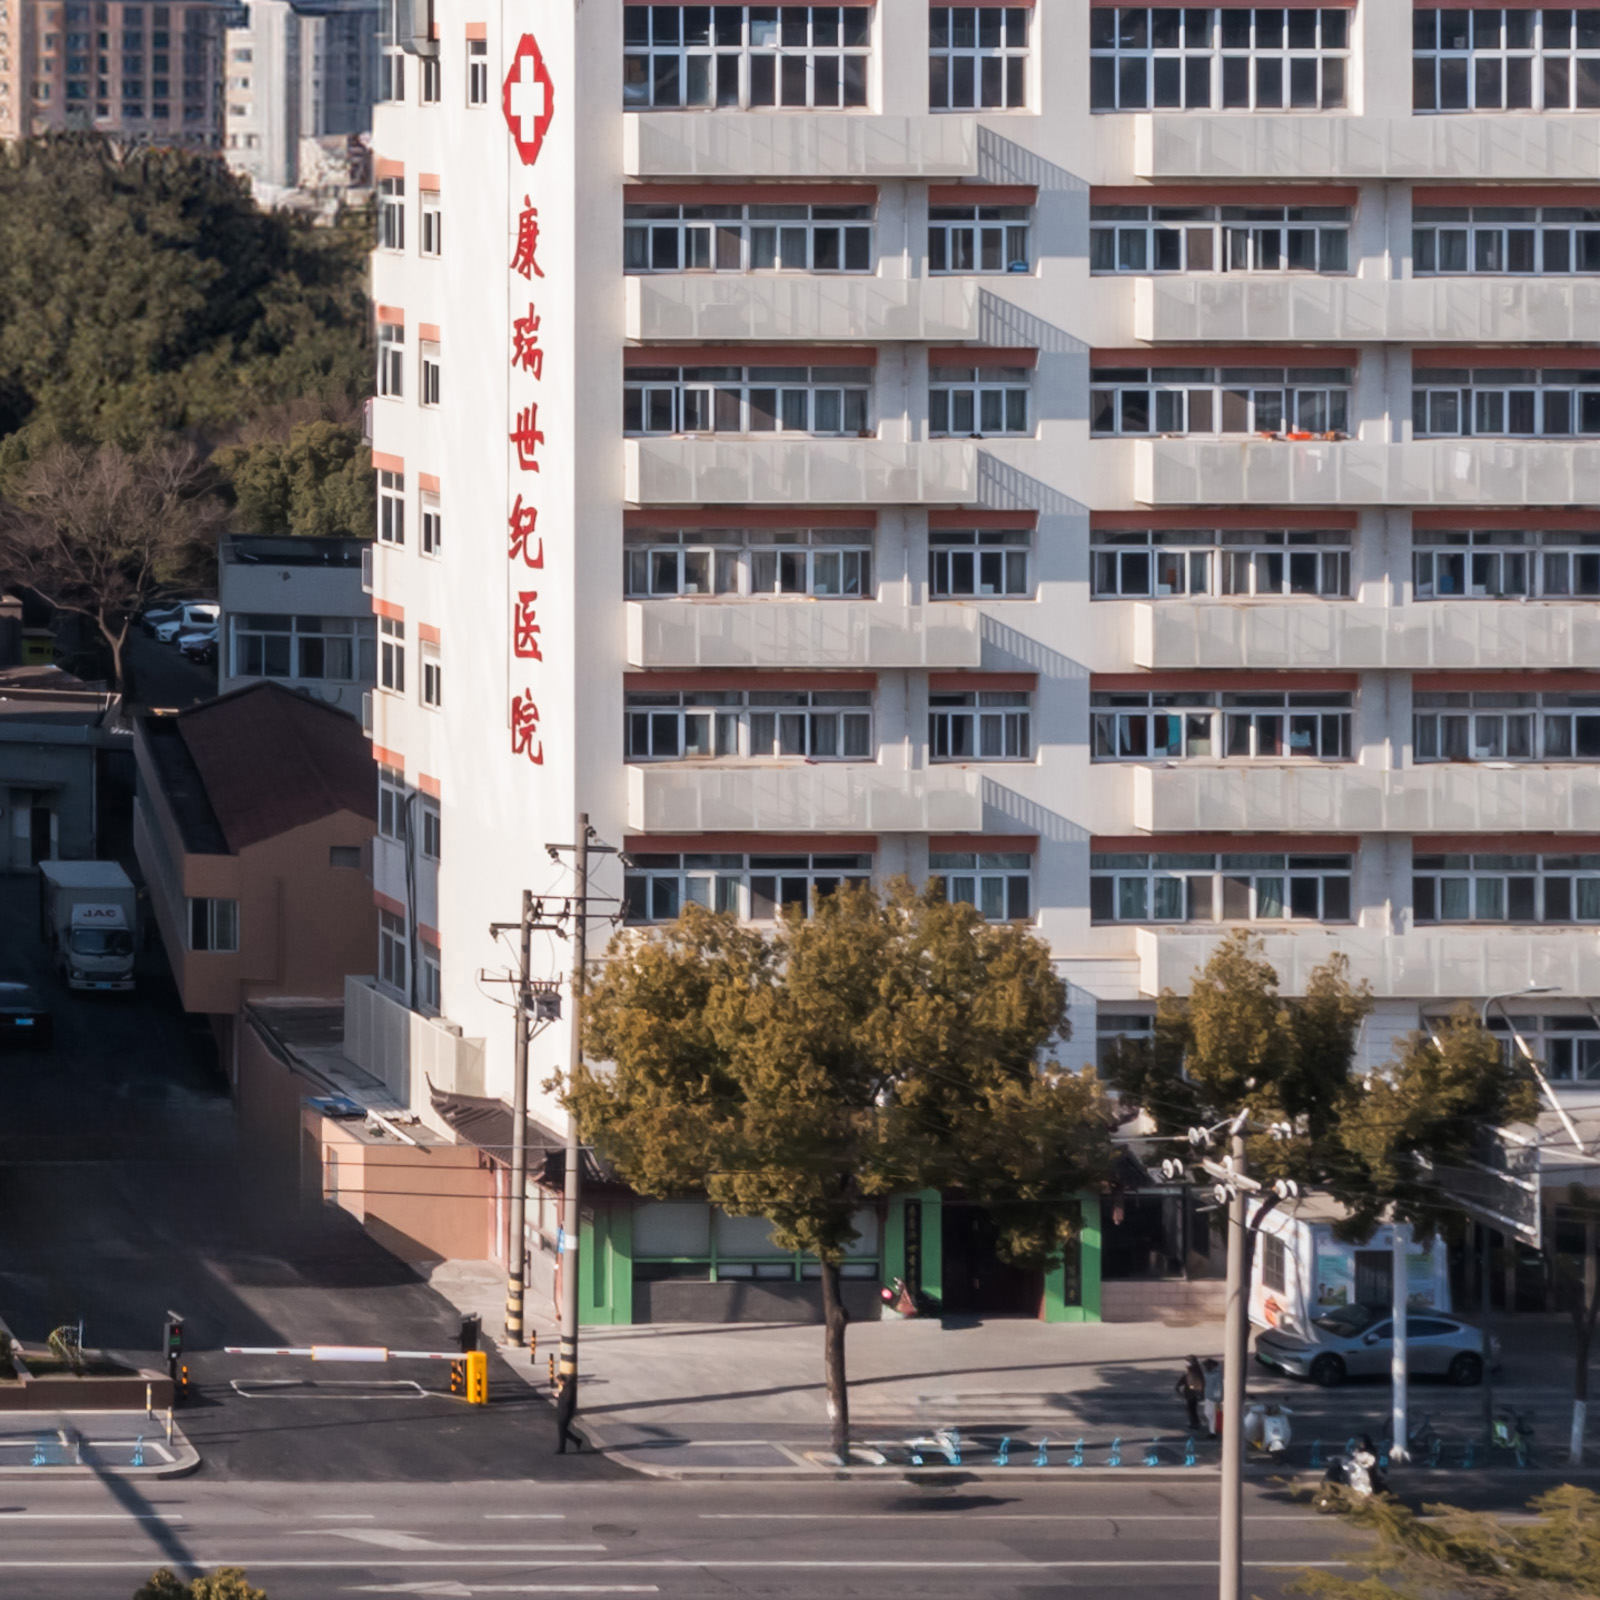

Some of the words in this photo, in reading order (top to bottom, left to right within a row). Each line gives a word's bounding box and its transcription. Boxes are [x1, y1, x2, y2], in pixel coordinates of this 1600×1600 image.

[508, 193, 546, 767] 康瑞世纪医院
[84, 909, 115, 917] JAC
